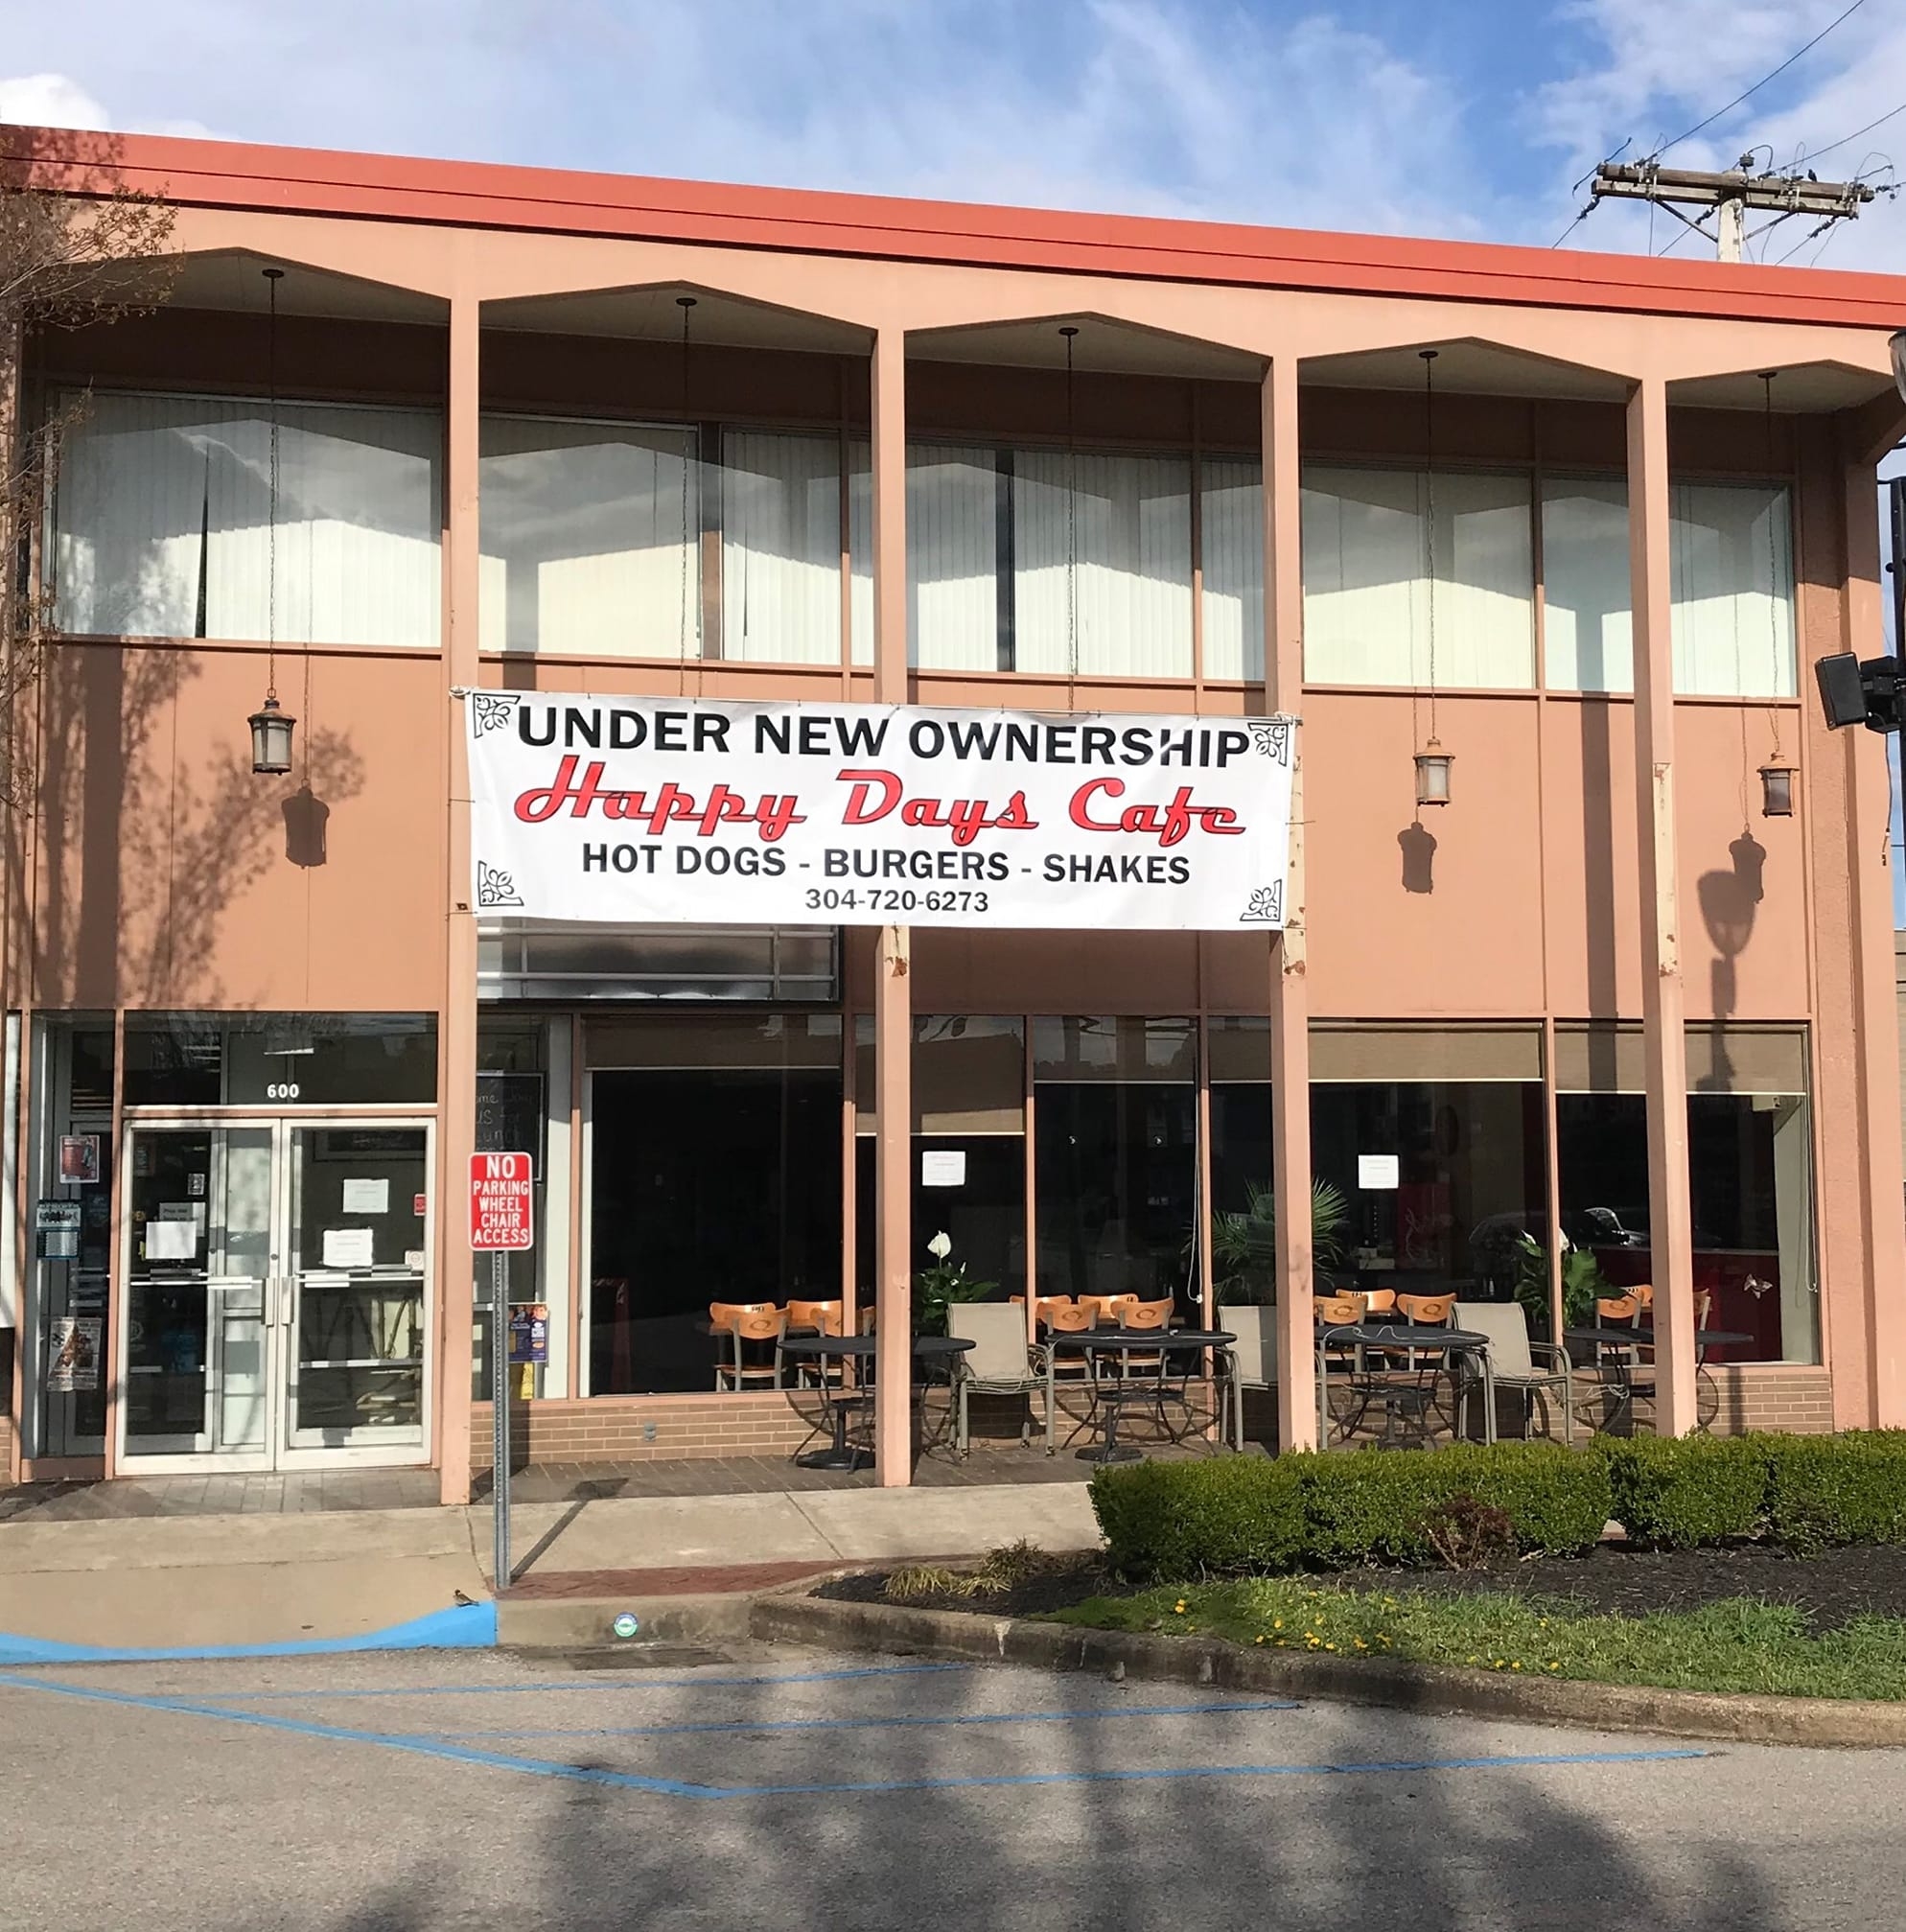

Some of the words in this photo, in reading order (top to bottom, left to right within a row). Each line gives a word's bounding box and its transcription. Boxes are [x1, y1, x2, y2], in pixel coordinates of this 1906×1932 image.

[518, 706, 731, 753] UNDER
[755, 714, 890, 757] NEW
[909, 719, 1249, 768] OWNERSHIP
[513, 754, 807, 843] Happy
[835, 768, 1039, 848] Days
[1068, 777, 1246, 848] Cafe
[583, 843, 662, 873] HOT
[676, 846, 786, 876] DOGS
[825, 849, 1010, 881] BURGERS
[1042, 853, 1191, 885] SHAKES
[806, 888, 989, 913] 304-720-6273
[267, 1083, 300, 1099] 600
[486, 1155, 516, 1179] NO
[472, 1179, 529, 1196] PARKING
[478, 1196, 524, 1212] WHEEL
[480, 1212, 521, 1228] CHAIR
[472, 1227, 529, 1245] ACCESS
